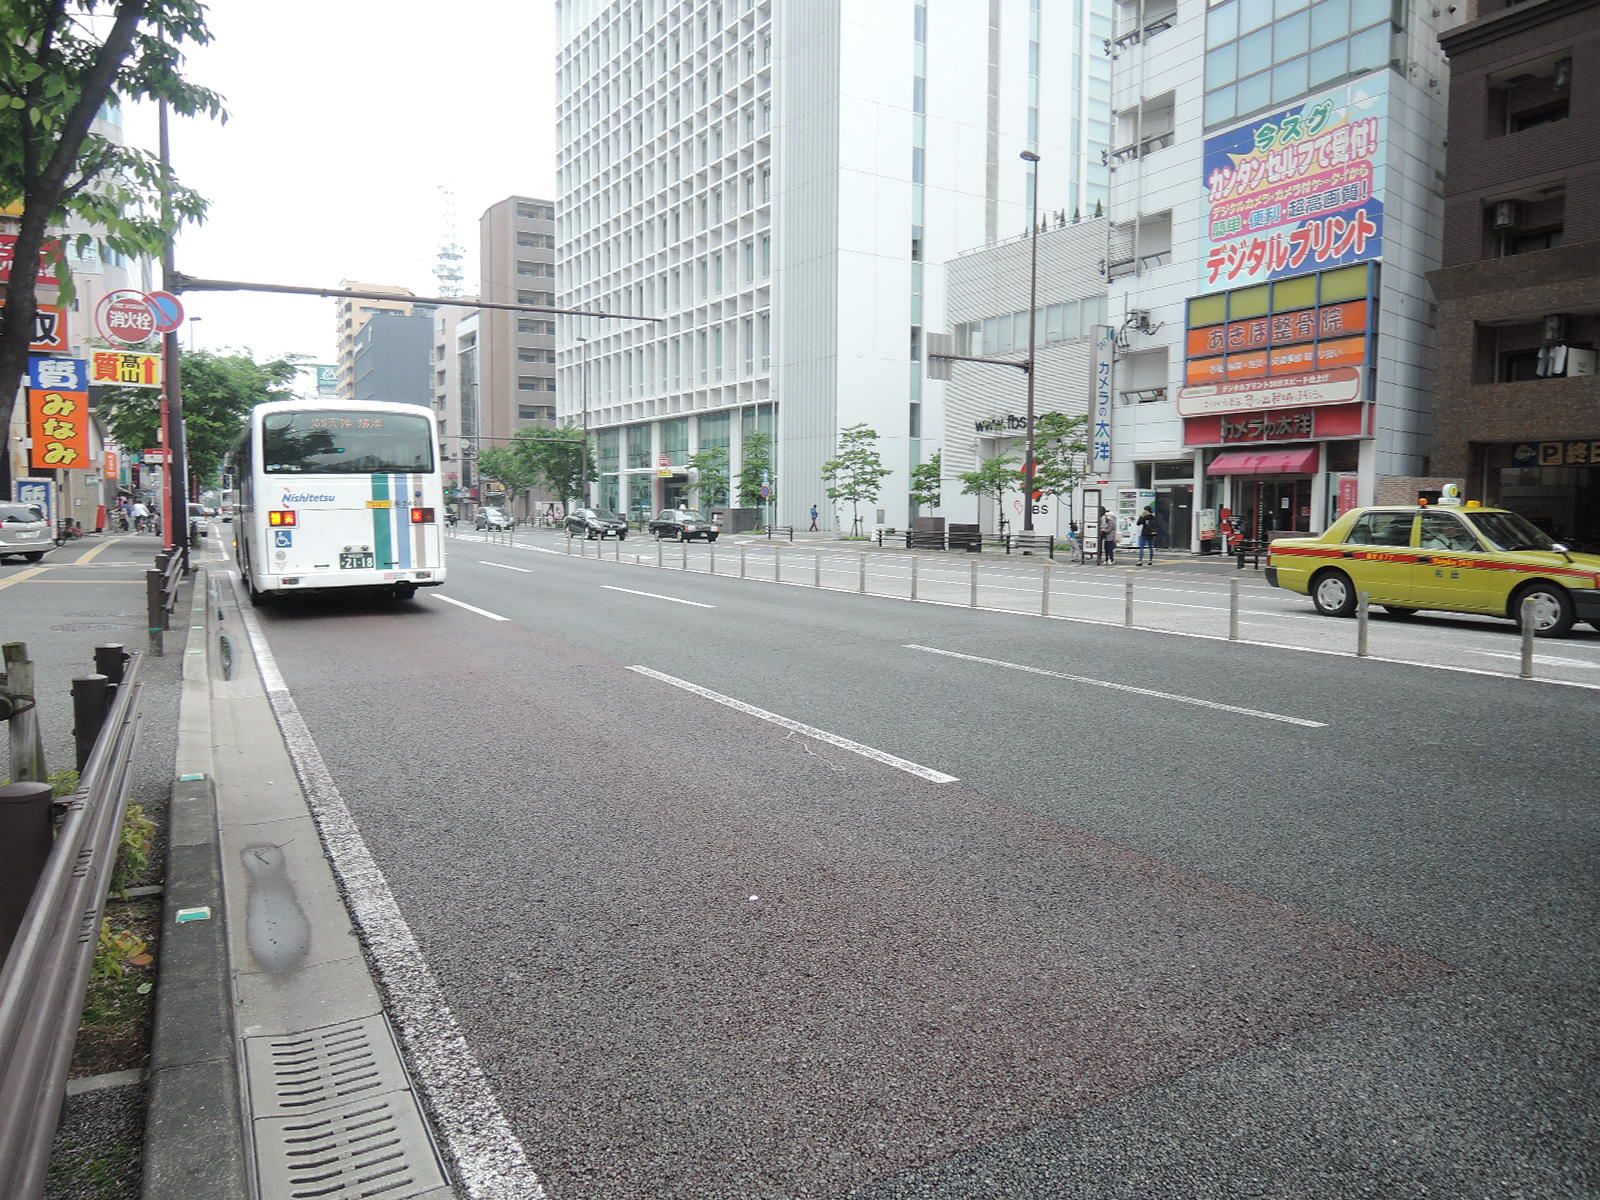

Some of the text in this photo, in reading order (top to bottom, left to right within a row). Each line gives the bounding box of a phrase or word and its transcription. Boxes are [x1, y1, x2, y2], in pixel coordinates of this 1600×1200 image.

[1255, 99, 1333, 152] 今スグ
[1206, 209, 1377, 285] デジタルプリント
[109, 310, 152, 330] 消火栓
[37, 359, 78, 389] 質
[93, 352, 140, 382] 質 高山
[41, 393, 77, 466] みなみ
[281, 493, 336, 503] Nishitetsu
[1032, 504, 1049, 515] BS
